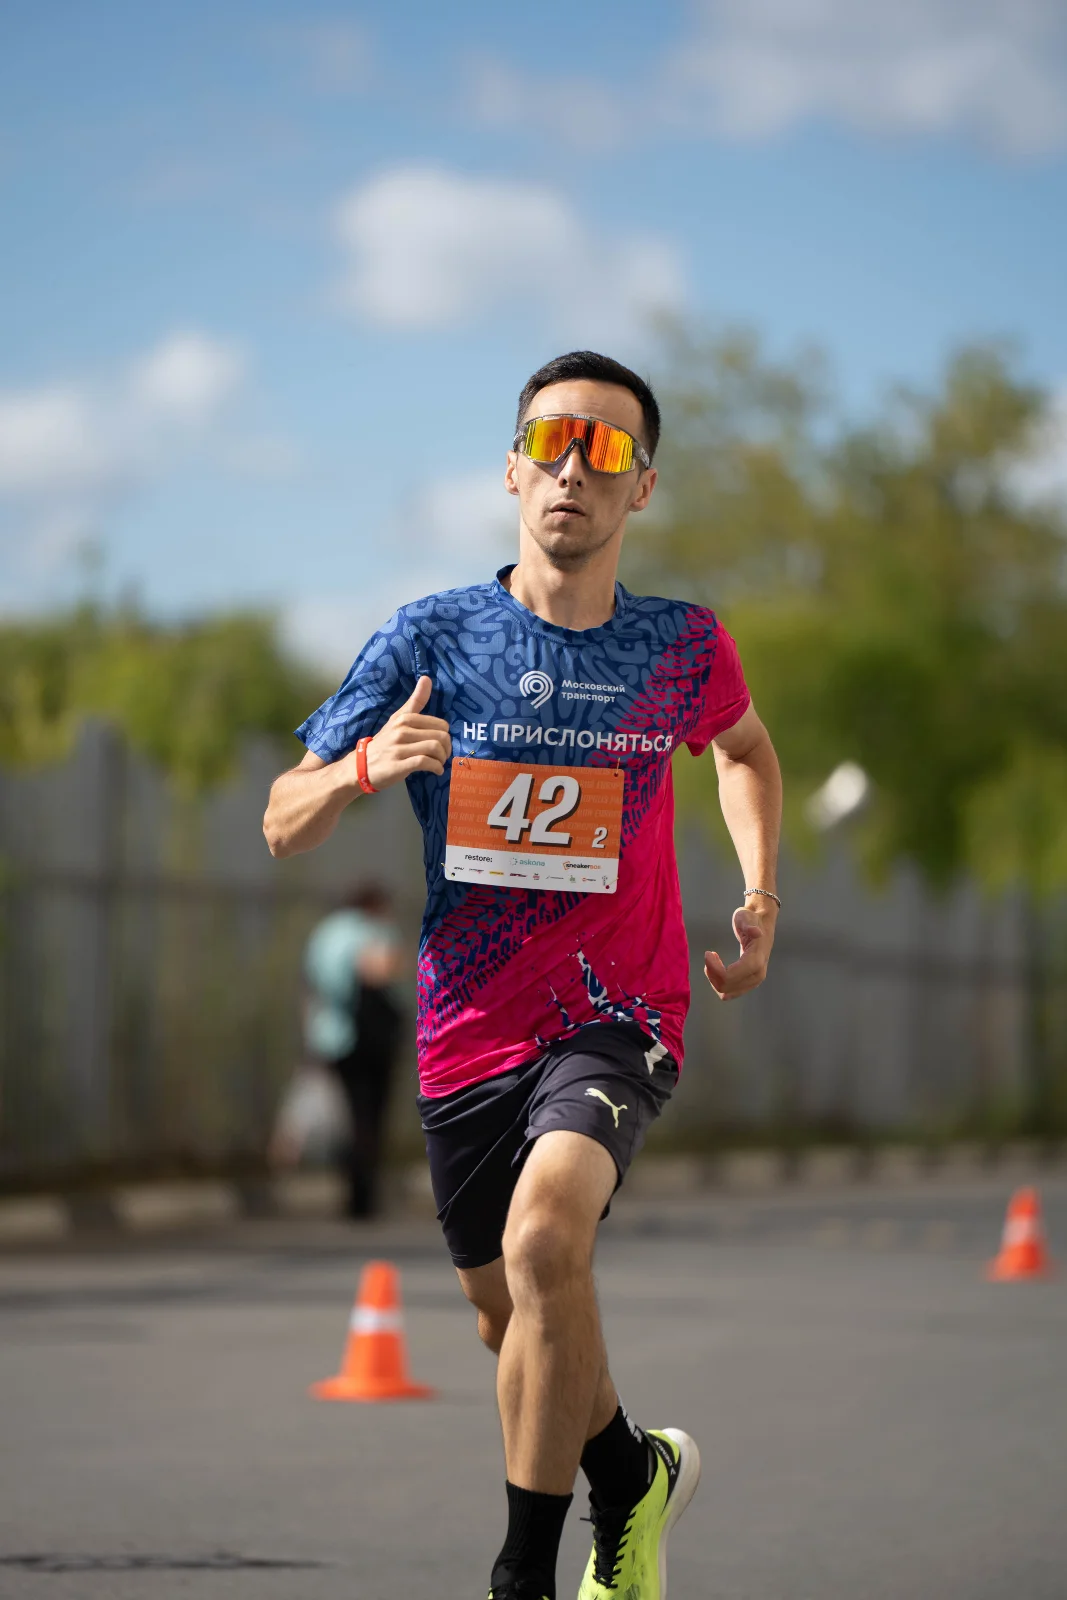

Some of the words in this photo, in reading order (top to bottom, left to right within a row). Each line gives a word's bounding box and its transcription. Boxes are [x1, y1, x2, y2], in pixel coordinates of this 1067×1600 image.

[561, 679, 626, 693] Московский
[561, 691, 616, 704] транспорт
[463, 721, 488, 741] НЕ
[493, 723, 673, 752] ПРИСЛОНЯТЬСЯ
[487, 773, 581, 847] 42
[591, 827, 608, 849] 2
[464, 854, 493, 863] restore:
[519, 858, 546, 867] askona
